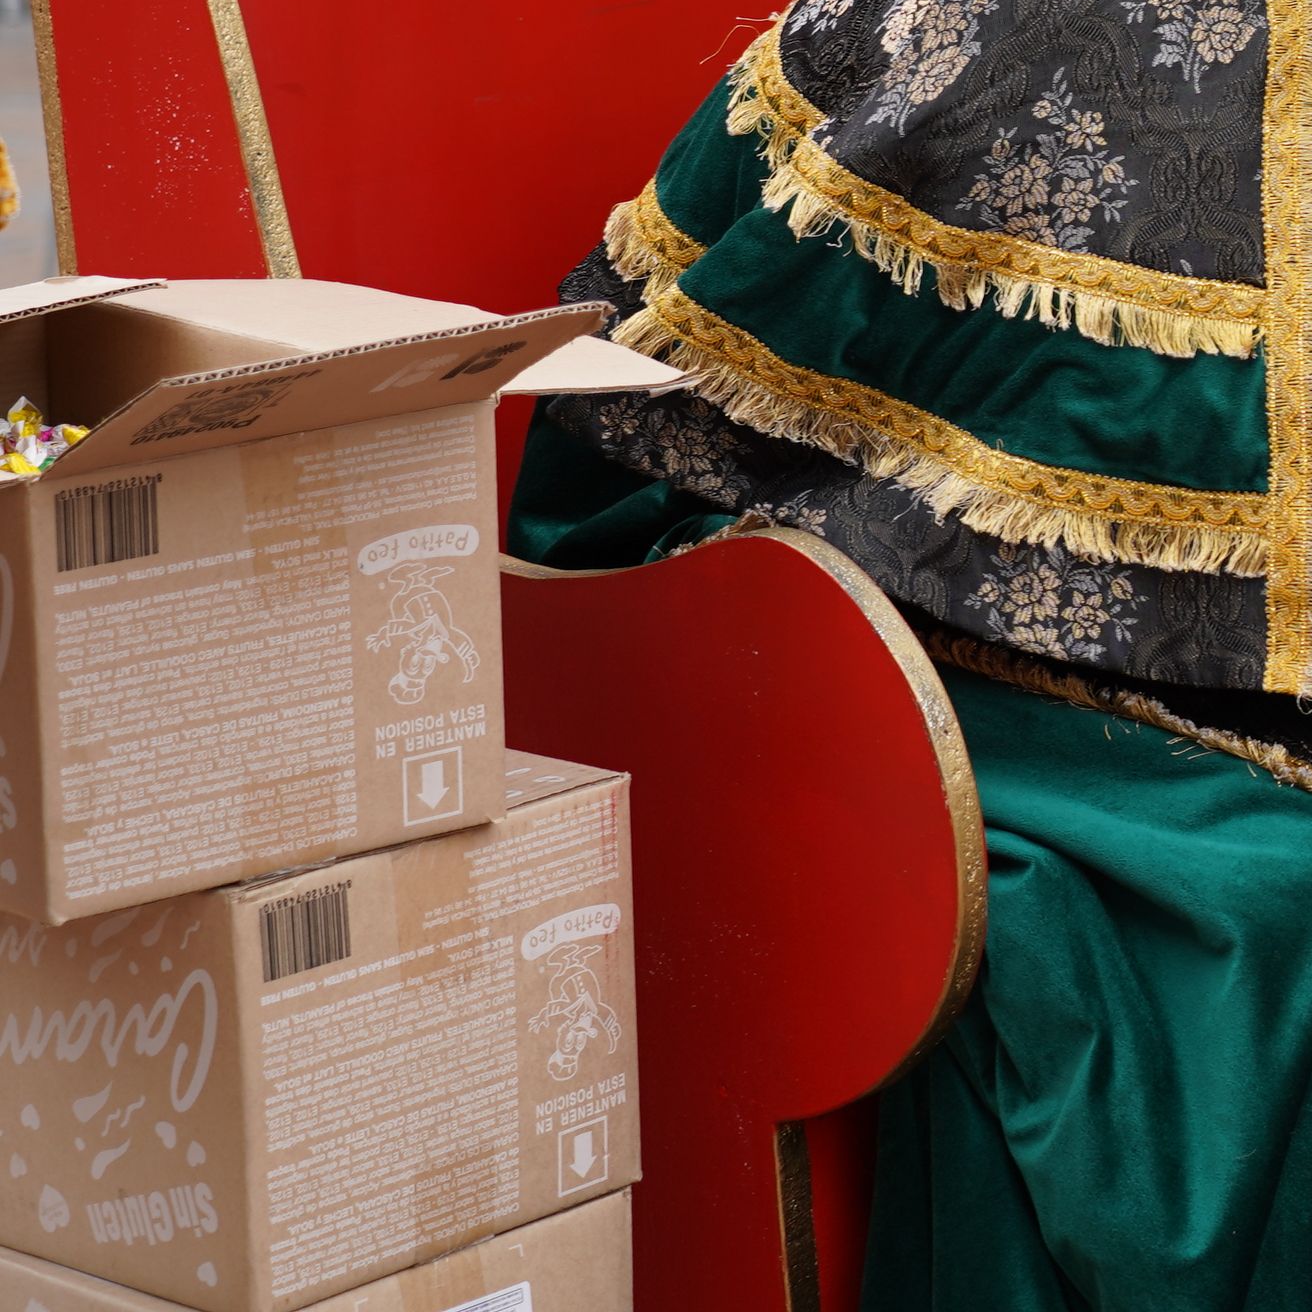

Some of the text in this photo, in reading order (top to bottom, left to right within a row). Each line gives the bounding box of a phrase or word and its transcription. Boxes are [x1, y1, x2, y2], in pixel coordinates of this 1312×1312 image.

[263, 539, 301, 556] GLUTEN
[303, 535, 320, 549] SIN
[367, 531, 470, 562] Patito feo
[195, 551, 234, 568] GLUTEN
[235, 547, 256, 561] SEM
[302, 550, 320, 563] and
[322, 545, 347, 560] MILK
[126, 563, 164, 581] GLUTEN
[166, 558, 193, 574] SANS
[53, 580, 76, 594] FREE
[78, 572, 117, 590] GLUTEN
[322, 604, 350, 620] HARD
[338, 620, 350, 632] de
[197, 645, 225, 660] AVEC
[226, 637, 263, 655] FRUITS
[113, 662, 137, 677] LAIT
[301, 678, 352, 700] CARAMELS
[340, 693, 353, 706] de
[222, 718, 236, 731] DE
[237, 709, 278, 728] FRUTAS
[375, 703, 486, 741] ESTA POSICION
[149, 730, 179, 747] LEITE
[375, 721, 486, 759] MANTENER EN
[292, 751, 355, 776] CARAMELOS
[277, 770, 341, 795] CACAHUETE,
[343, 767, 355, 780] de
[215, 795, 232, 809] DE
[233, 785, 275, 805] FRUTOS
[124, 811, 160, 829] LECHE
[294, 824, 357, 851] CARAMELOS
[474, 924, 489, 939] SIN
[529, 910, 613, 948] Patito feo
[441, 929, 473, 950] GLUTEN
[474, 940, 490, 955] and
[491, 933, 513, 950] MILK
[382, 948, 416, 969] GLUTEN
[416, 942, 434, 958] SEM
[357, 958, 382, 977] SANS
[323, 966, 357, 988] GLUTEN
[260, 991, 281, 1009] FREE
[281, 980, 316, 1002] GLUTEN
[506, 1075, 518, 1089] de
[535, 1072, 626, 1118] ESTA POSICION
[405, 1109, 419, 1124] DE
[419, 1097, 454, 1119] FRUTAS
[535, 1089, 626, 1135] MANTENER EN
[343, 1126, 370, 1145] LEITE
[508, 1145, 519, 1159] de
[400, 1181, 415, 1196] DE
[415, 1169, 451, 1191] FRUTOS
[466, 1201, 519, 1229] CARAMELOS
